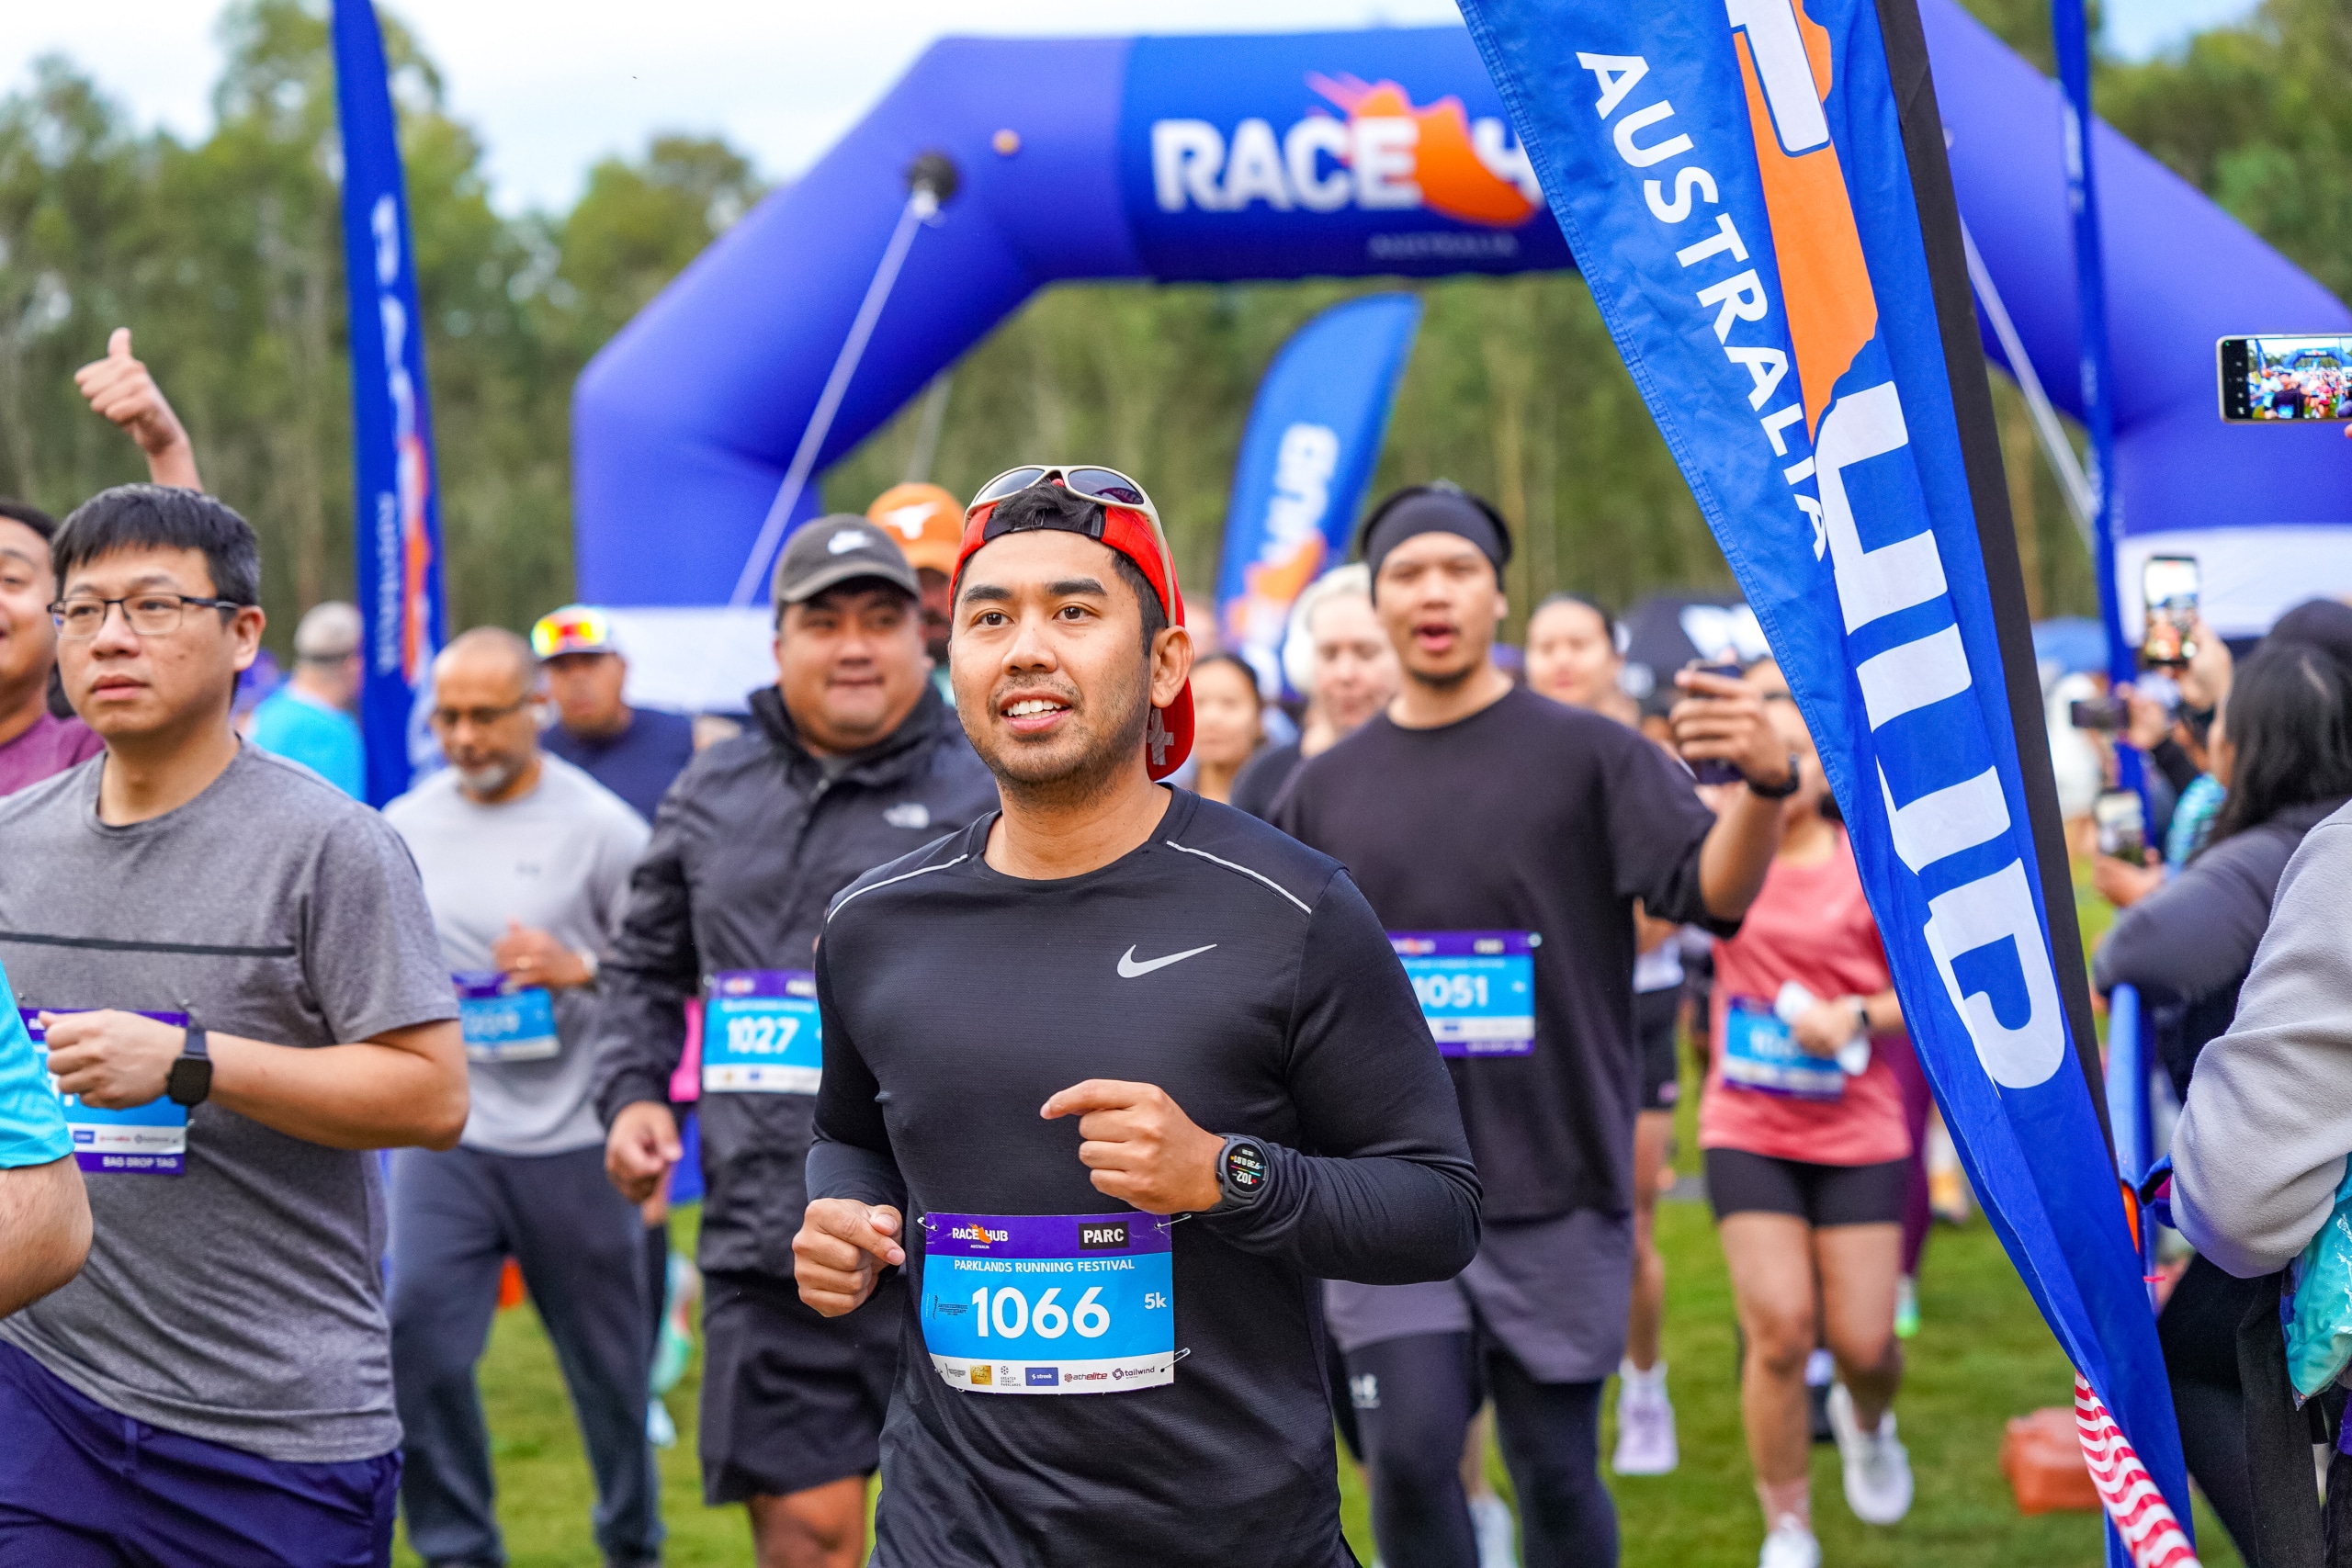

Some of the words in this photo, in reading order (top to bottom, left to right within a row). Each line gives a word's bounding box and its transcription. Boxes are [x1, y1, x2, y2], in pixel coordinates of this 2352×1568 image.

[1152, 117, 1423, 212] RACE
[1576, 51, 1828, 563] AUSTRALIA
[1413, 974, 1488, 1008] 1051
[727, 1015, 800, 1055] 1027
[103, 1156, 125, 1168] BAG
[127, 1156, 153, 1168] DROP
[156, 1157, 177, 1168] TAG
[952, 1227, 980, 1240] RACE
[984, 1229, 1009, 1242] HUB
[1083, 1228, 1125, 1244] PARC
[954, 1259, 1012, 1273] PARKLANDS
[1014, 1261, 1074, 1274] RUNNING
[1077, 1258, 1136, 1273] FESTIVAL
[1144, 1292, 1167, 1310] 5k
[971, 1286, 1111, 1339] 1066
[1073, 1371, 1108, 1381] athelite
[1125, 1366, 1155, 1377] tailwind
